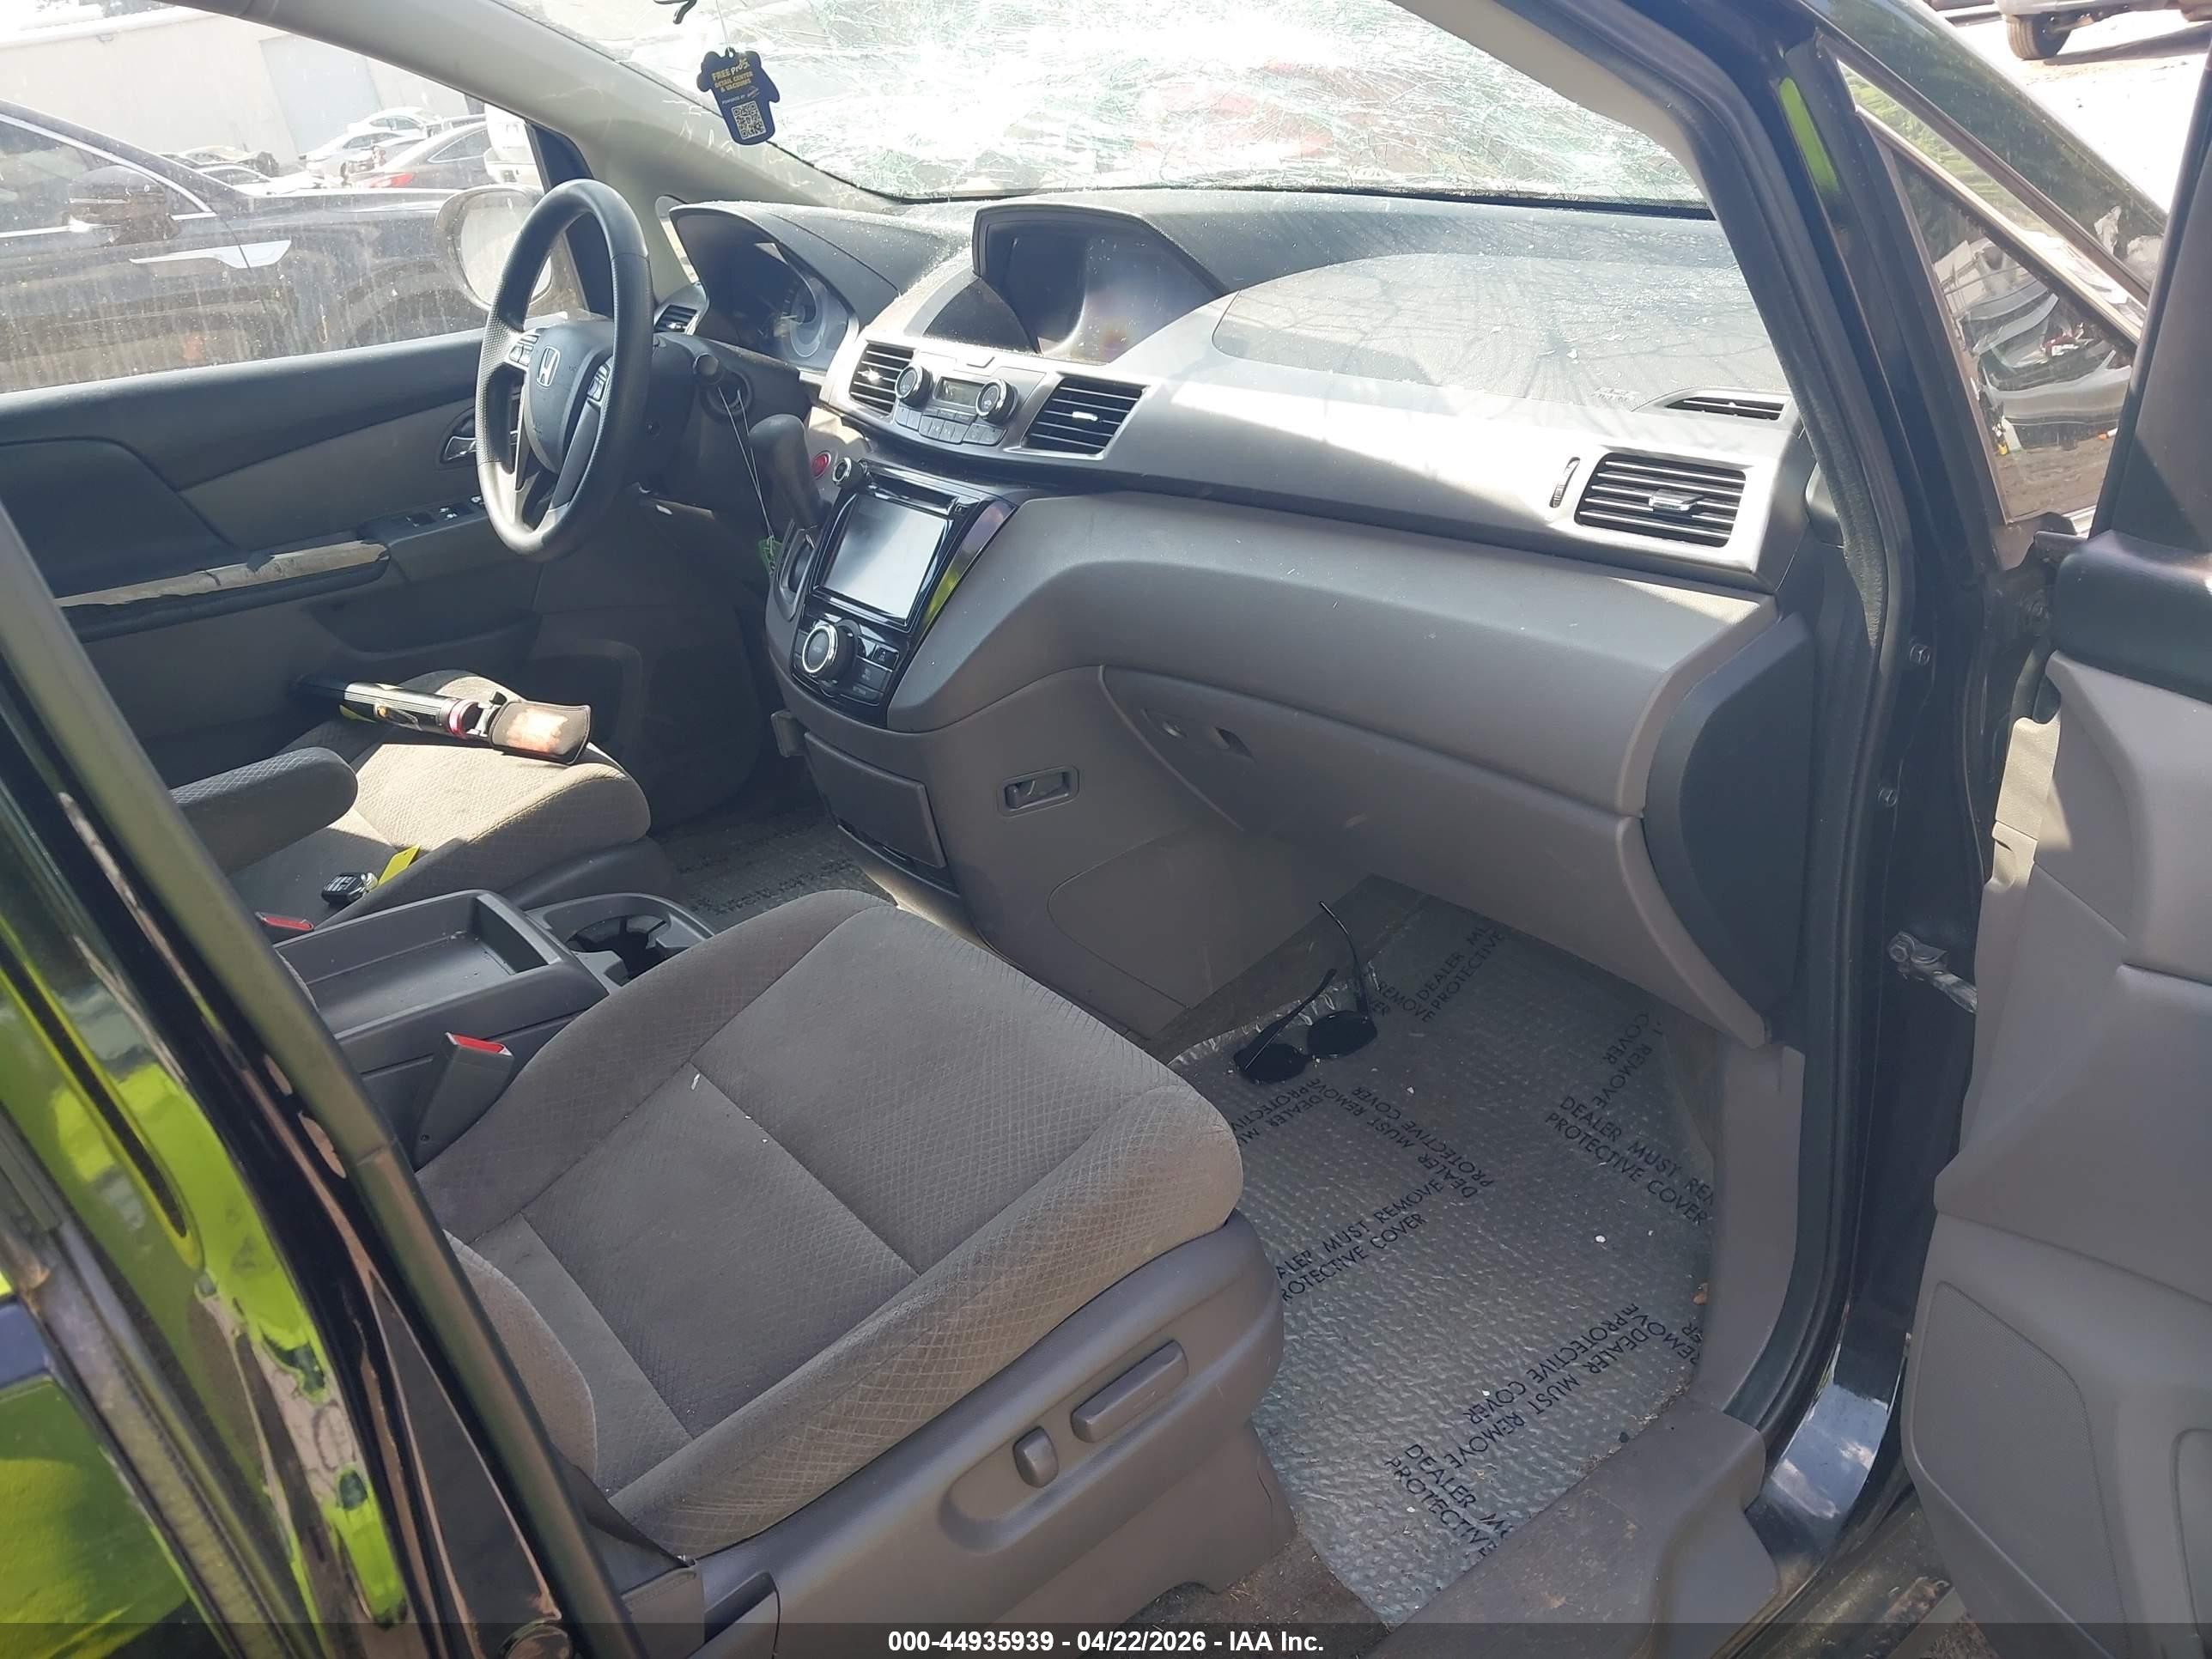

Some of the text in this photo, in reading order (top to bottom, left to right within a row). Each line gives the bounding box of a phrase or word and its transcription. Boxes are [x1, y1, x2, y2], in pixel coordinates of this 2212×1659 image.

[1377, 981, 1436, 1023] REMOVE
[1416, 951, 1465, 1001] DEALER
[1431, 931, 1505, 1010] PROTECTIVE
[1602, 1014, 1649, 1064] COVER
[1231, 1086, 1310, 1132] PROTECTIV
[1593, 1044, 1653, 1109] REMOVE
[1265, 1094, 1323, 1127] DEALER
[1306, 1078, 1478, 1199] DEALER MUST REMOVE
[1352, 1086, 1494, 1188] PROTECTIVE COVER
[1559, 1096, 1622, 1142] DEALER
[1627, 1140, 1683, 1177] MUST
[1545, 1112, 1707, 1226] PROTECTIVE COVER
[1275, 1179, 1444, 1279] ALER MUST REMOVE
[1281, 1213, 1427, 1302] ROTECTIVE COVER
[1526, 1313, 1628, 1383] PROTECTIVE
[1583, 1328, 1650, 1374] DEALER
[1463, 1381, 1526, 1425] COVER
[1528, 1374, 1580, 1415] MUST
[1443, 1412, 1525, 1469] REMOVE
[1384, 1456, 1498, 1557] PROTECTIVE
[1405, 1443, 1476, 1509] DEALER
